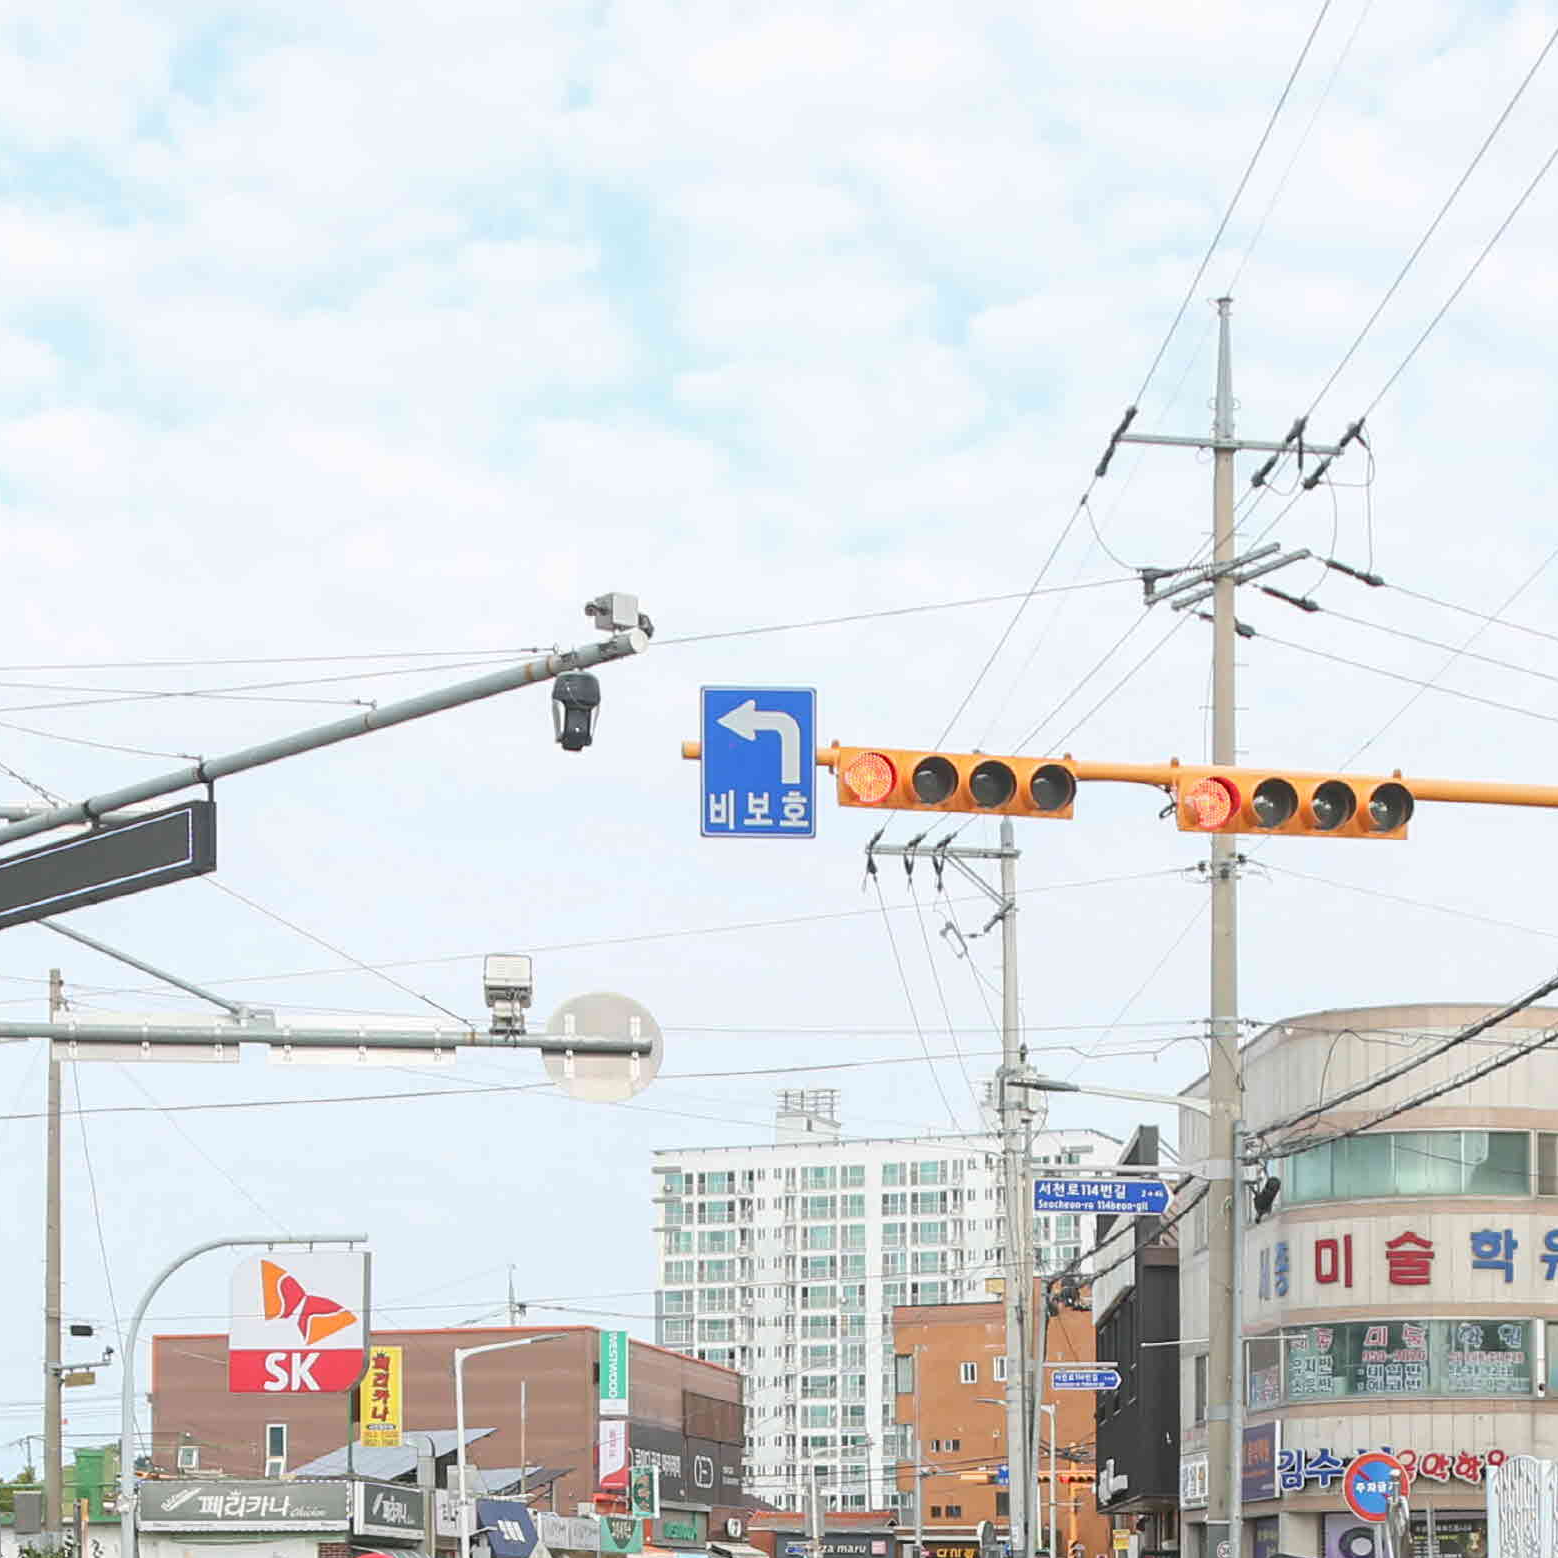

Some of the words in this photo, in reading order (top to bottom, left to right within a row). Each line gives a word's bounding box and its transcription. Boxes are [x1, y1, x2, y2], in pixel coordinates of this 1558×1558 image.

[709, 789, 810, 830] 비보호
[263, 1351, 321, 1392] SK
[199, 1493, 290, 1517] 페리카나
